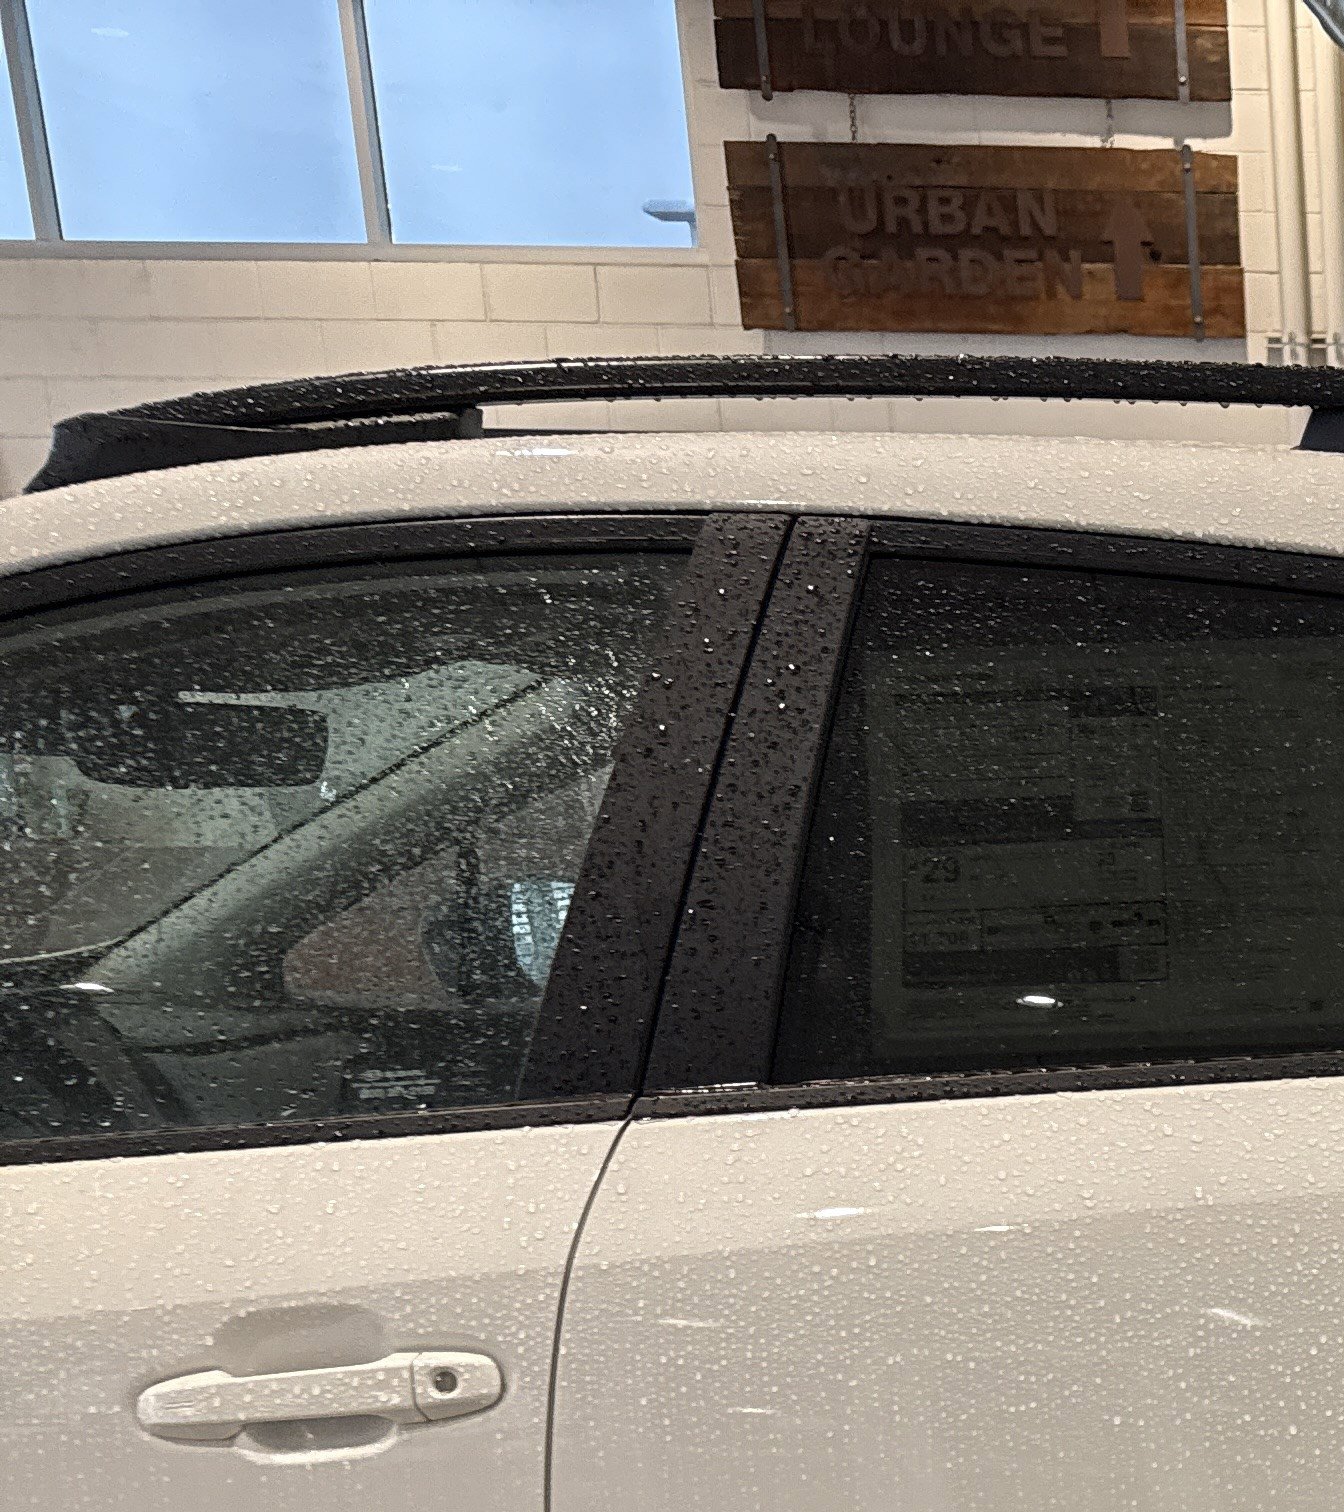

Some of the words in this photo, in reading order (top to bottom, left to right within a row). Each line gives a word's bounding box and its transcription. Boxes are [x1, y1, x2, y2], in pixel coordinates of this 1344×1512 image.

[802, 4, 1068, 59] LOUNGE
[839, 184, 1058, 237] URBAN
[821, 247, 1083, 301] GARDEN
